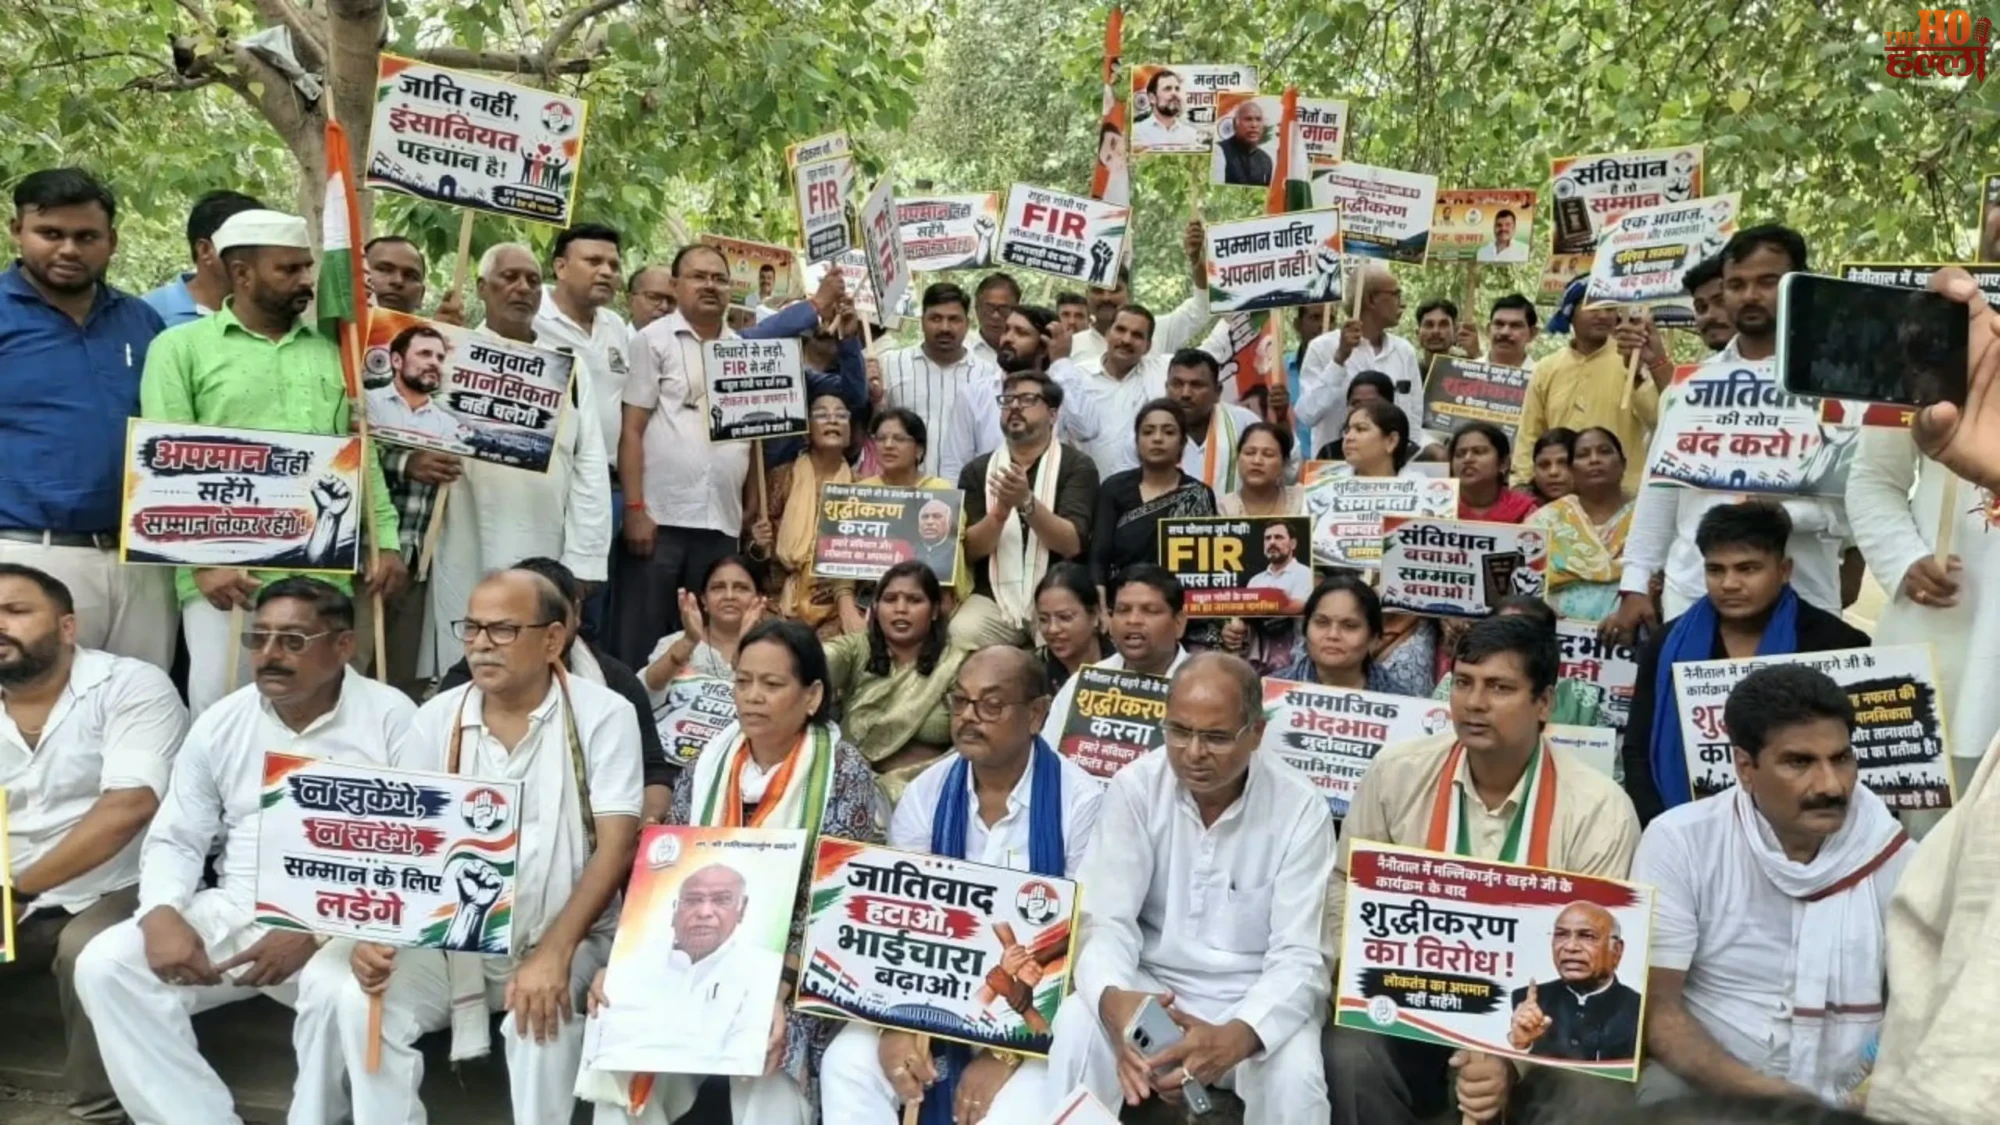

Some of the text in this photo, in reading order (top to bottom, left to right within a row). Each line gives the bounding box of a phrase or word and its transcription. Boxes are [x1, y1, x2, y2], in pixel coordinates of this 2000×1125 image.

[1194, 71, 1240, 91] मनुवादी
[399, 73, 519, 121] जाति नहीं,
[389, 103, 519, 152] इंसानियत
[397, 139, 480, 173] पहचान
[1572, 158, 1668, 186] संविधान
[808, 179, 841, 214] FIR
[1589, 193, 1661, 213] सम्मान
[1022, 202, 1087, 240] FIR
[1621, 215, 1650, 232] एक
[1214, 231, 1270, 258] सम्मान
[1273, 221, 1318, 249] चाहिए,
[1220, 260, 1275, 287] अपमान
[470, 343, 545, 378] मनुवादी
[723, 361, 747, 375] FIR
[452, 366, 562, 409] मानसिकता
[493, 400, 539, 427] चलेगी
[1716, 411, 1781, 427] की सोच
[1676, 426, 1725, 458] बंद
[152, 440, 314, 474] अपमान नहीं
[198, 476, 260, 505] सहेंगे,
[142, 511, 211, 536] सम्मान
[212, 507, 261, 535] लेकर
[824, 496, 906, 521] शुद्धीकरण
[1357, 510, 1381, 523] चाहि
[838, 520, 890, 537] करना
[1397, 525, 1497, 552] संविधान
[1168, 536, 1244, 572] FIR
[1403, 547, 1474, 568] बचाओ,
[1398, 566, 1476, 587] सम्मान
[1684, 664, 1726, 680] नैनीताल
[1728, 663, 1738, 677] में
[1844, 654, 1860, 669] जी
[1863, 653, 1875, 668] के
[1285, 689, 1400, 720] सामाजिक
[1898, 683, 1916, 701] की
[1090, 716, 1155, 745] करना
[1290, 707, 1389, 741] भेदभाव
[1300, 735, 1373, 757] मुर्दाबाद!
[299, 776, 426, 818] न झुकेंगे,
[315, 820, 425, 856] न सहेंगे,
[284, 856, 443, 893] सम्मान के लिए
[847, 860, 998, 915] जातिवाद
[1376, 874, 1424, 894] कार्यक्रम
[1428, 878, 1441, 895] के
[1377, 855, 1420, 876] नैनीताल
[1421, 860, 1431, 877] में
[1433, 862, 1501, 888] मल्लिकार्जुन
[1540, 876, 1557, 893] जी
[1559, 879, 1573, 894] के
[865, 901, 956, 939] हटाओ,
[1361, 899, 1518, 943] शुद्धीकरण
[838, 924, 986, 977] भाईचारा
[1363, 936, 1407, 967] का
[1383, 974, 1490, 998] लोकतंत्र का अपमान
[1405, 990, 1427, 1008] नहीं
